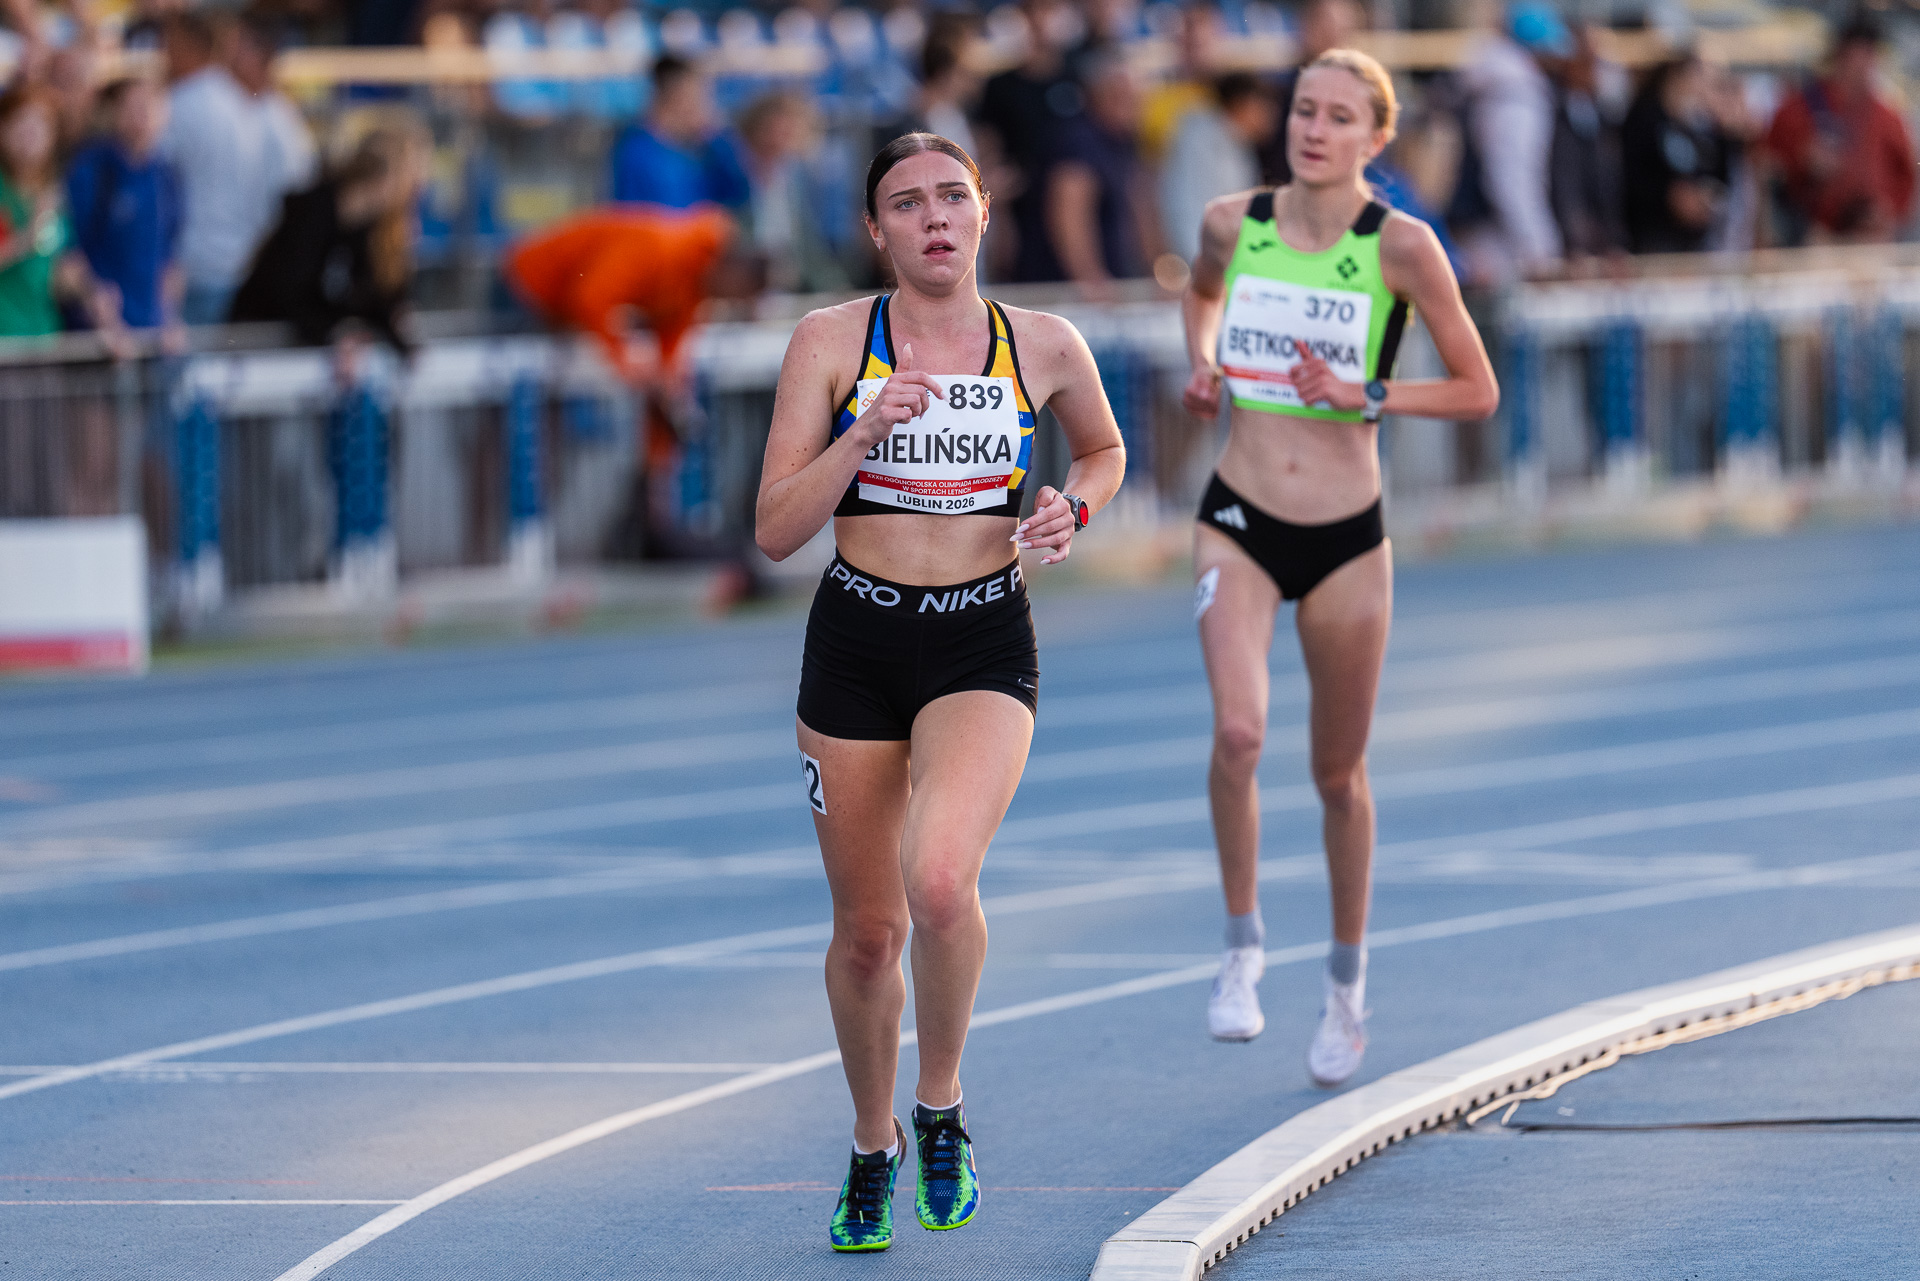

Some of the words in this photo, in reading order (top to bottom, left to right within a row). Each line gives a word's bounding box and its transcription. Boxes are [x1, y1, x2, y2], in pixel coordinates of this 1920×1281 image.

[1304, 295, 1356, 324] 370
[949, 384, 1003, 410] 839
[884, 476, 938, 488] OGÓLNOPOLSKA
[938, 480, 972, 488] OLIMPIADA
[910, 487, 947, 495] SPORTACH
[947, 487, 972, 495] LETNICH
[896, 493, 942, 510] LUBLIN
[945, 496, 975, 510] 2026
[830, 562, 901, 607] PRO
[917, 575, 1005, 613] NIKE
